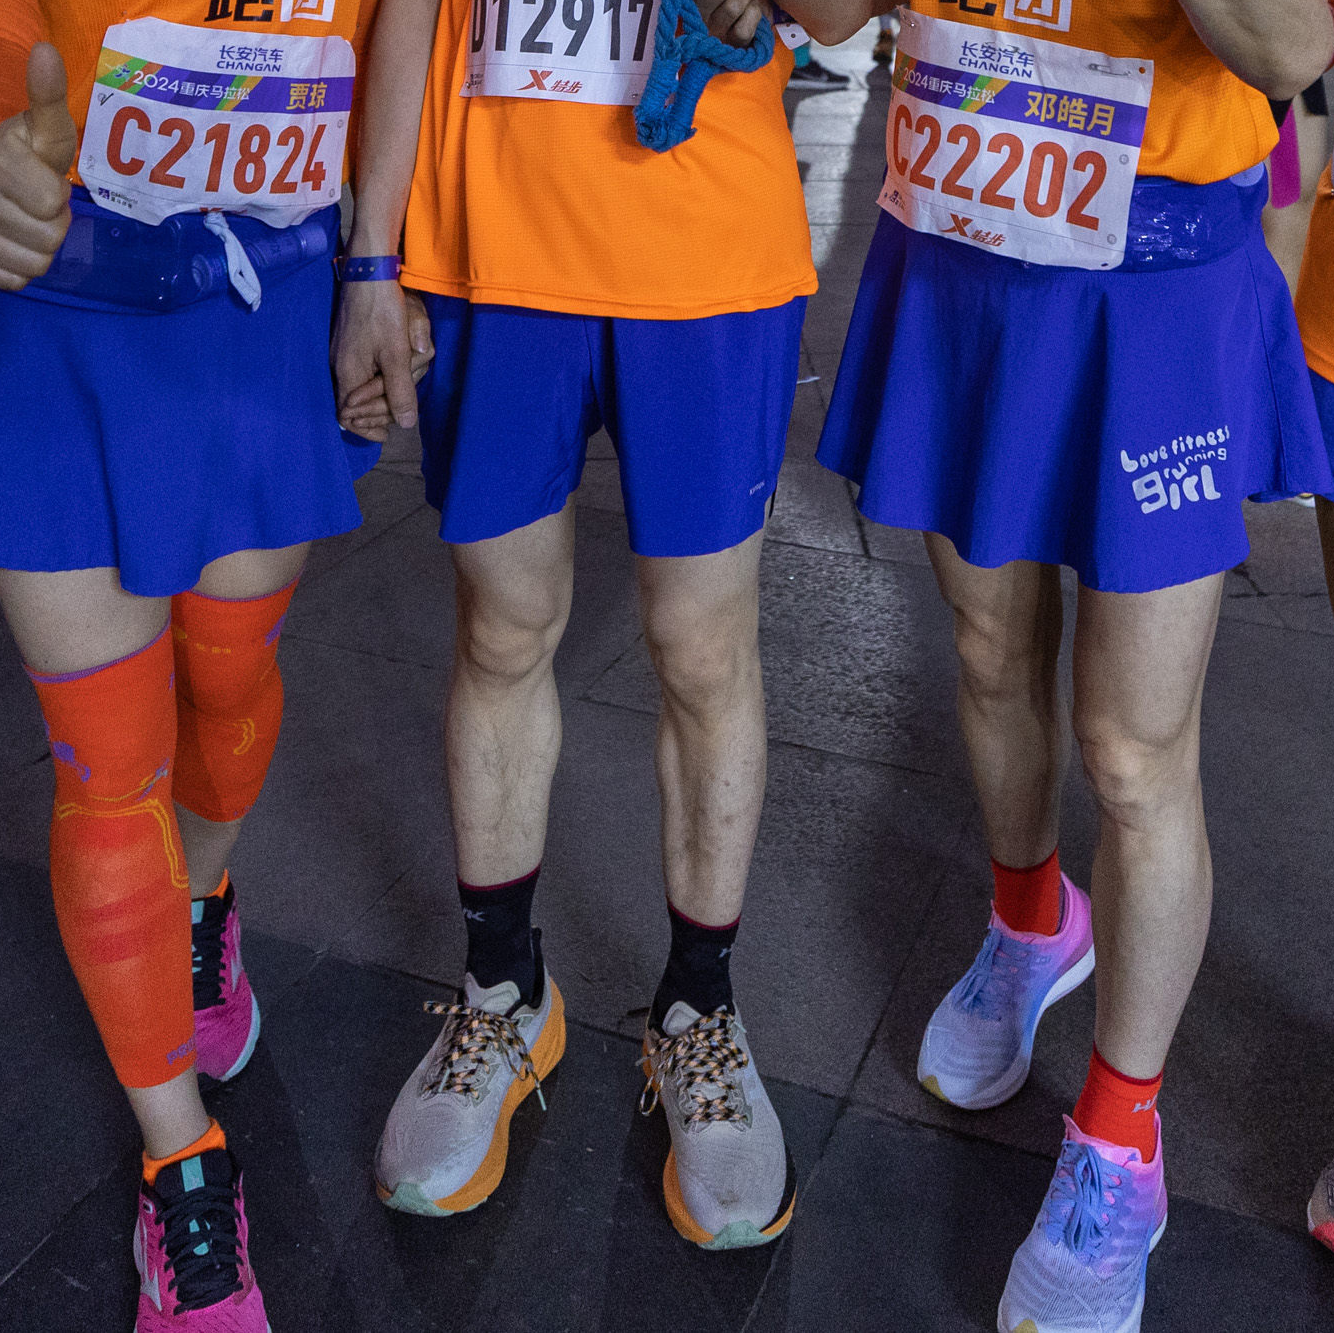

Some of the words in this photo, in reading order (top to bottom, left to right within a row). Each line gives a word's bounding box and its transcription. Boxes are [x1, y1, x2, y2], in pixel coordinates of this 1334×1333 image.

[216, 60, 282, 73] CHANGAN
[219, 44, 284, 63] 长安汽车
[958, 57, 1035, 79] CHANGAN
[960, 41, 1035, 68] 长安汽车
[132, 70, 251, 101] 2024重庆马拉松
[286, 81, 328, 110] 贾琼
[902, 65, 996, 105] 2024重庆马拉松
[1024, 90, 1116, 137] 邓皓月
[106, 106, 328, 195] C21824
[893, 104, 1108, 231] C22202
[1132, 464, 1221, 514] girl
